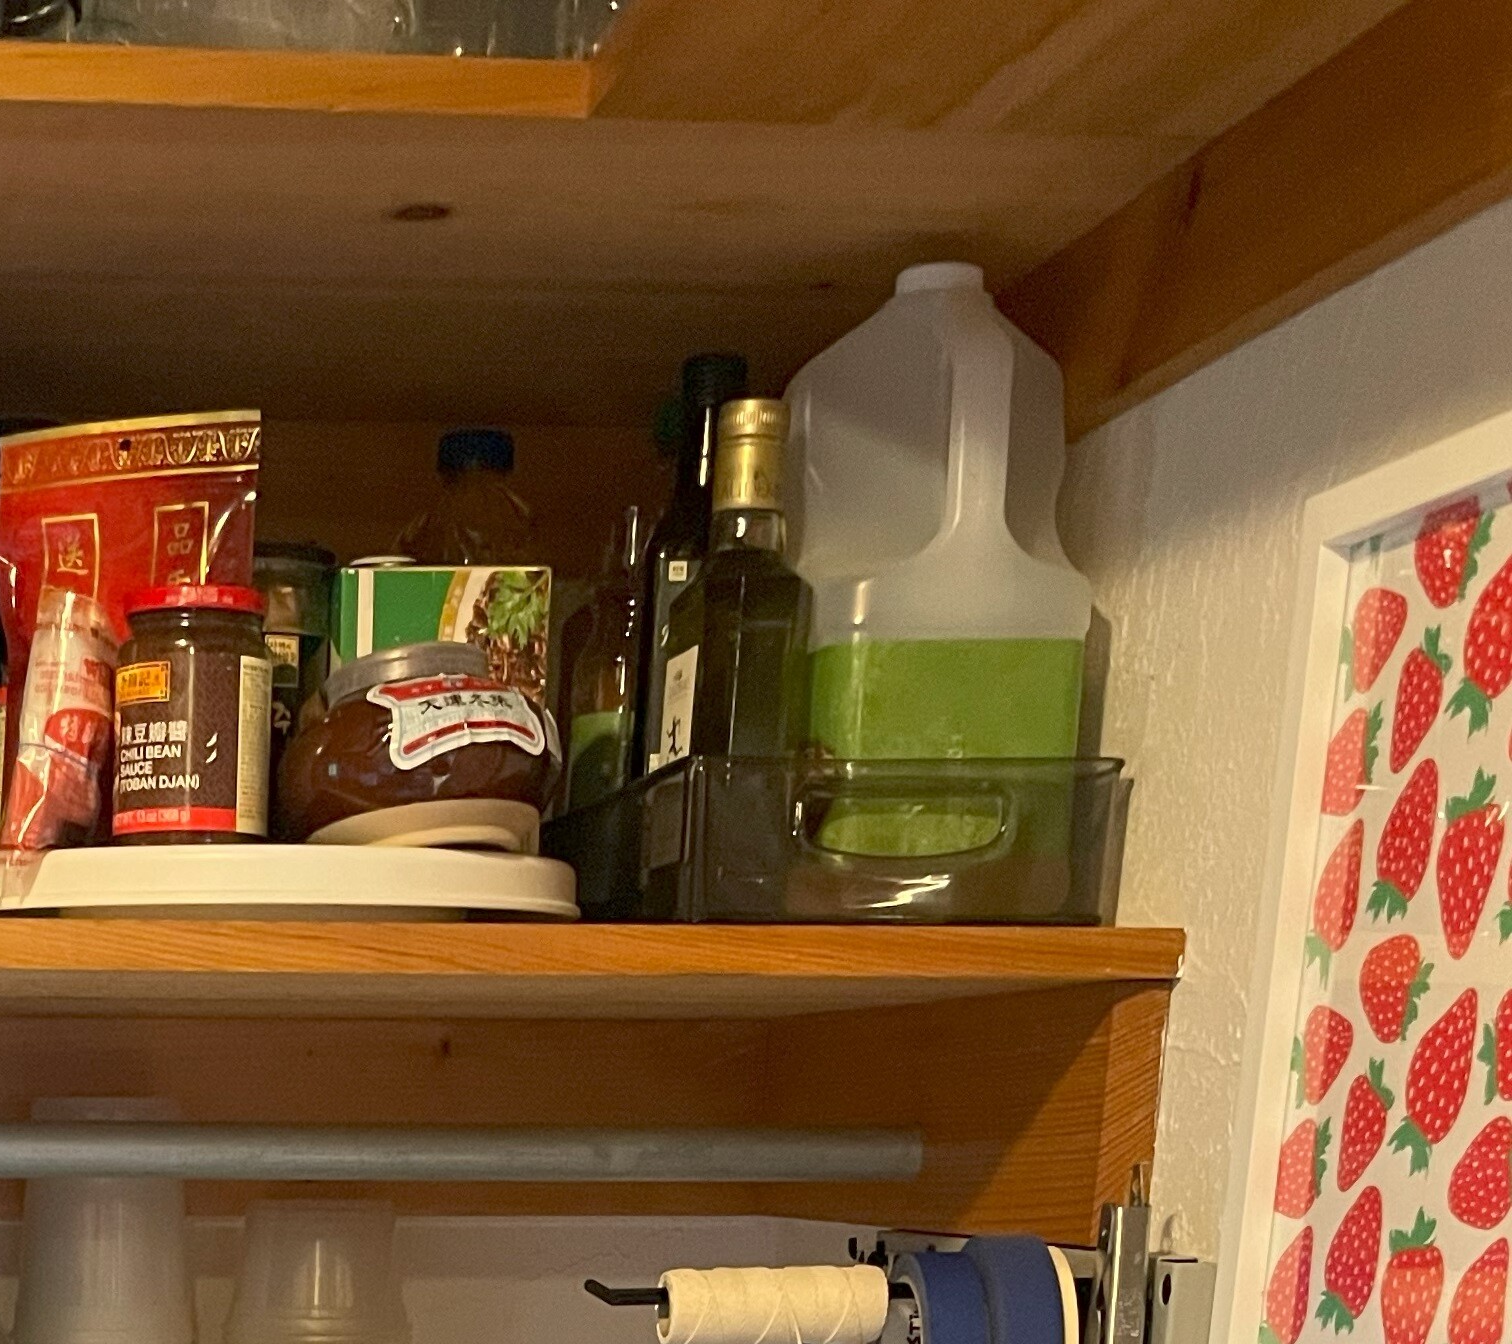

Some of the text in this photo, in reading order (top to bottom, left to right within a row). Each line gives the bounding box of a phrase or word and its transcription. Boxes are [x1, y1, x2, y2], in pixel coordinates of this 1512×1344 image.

[120, 744, 182, 764] CHILI BEAN
[120, 761, 153, 778] SAUCE
[159, 774, 200, 790] DJAN)
